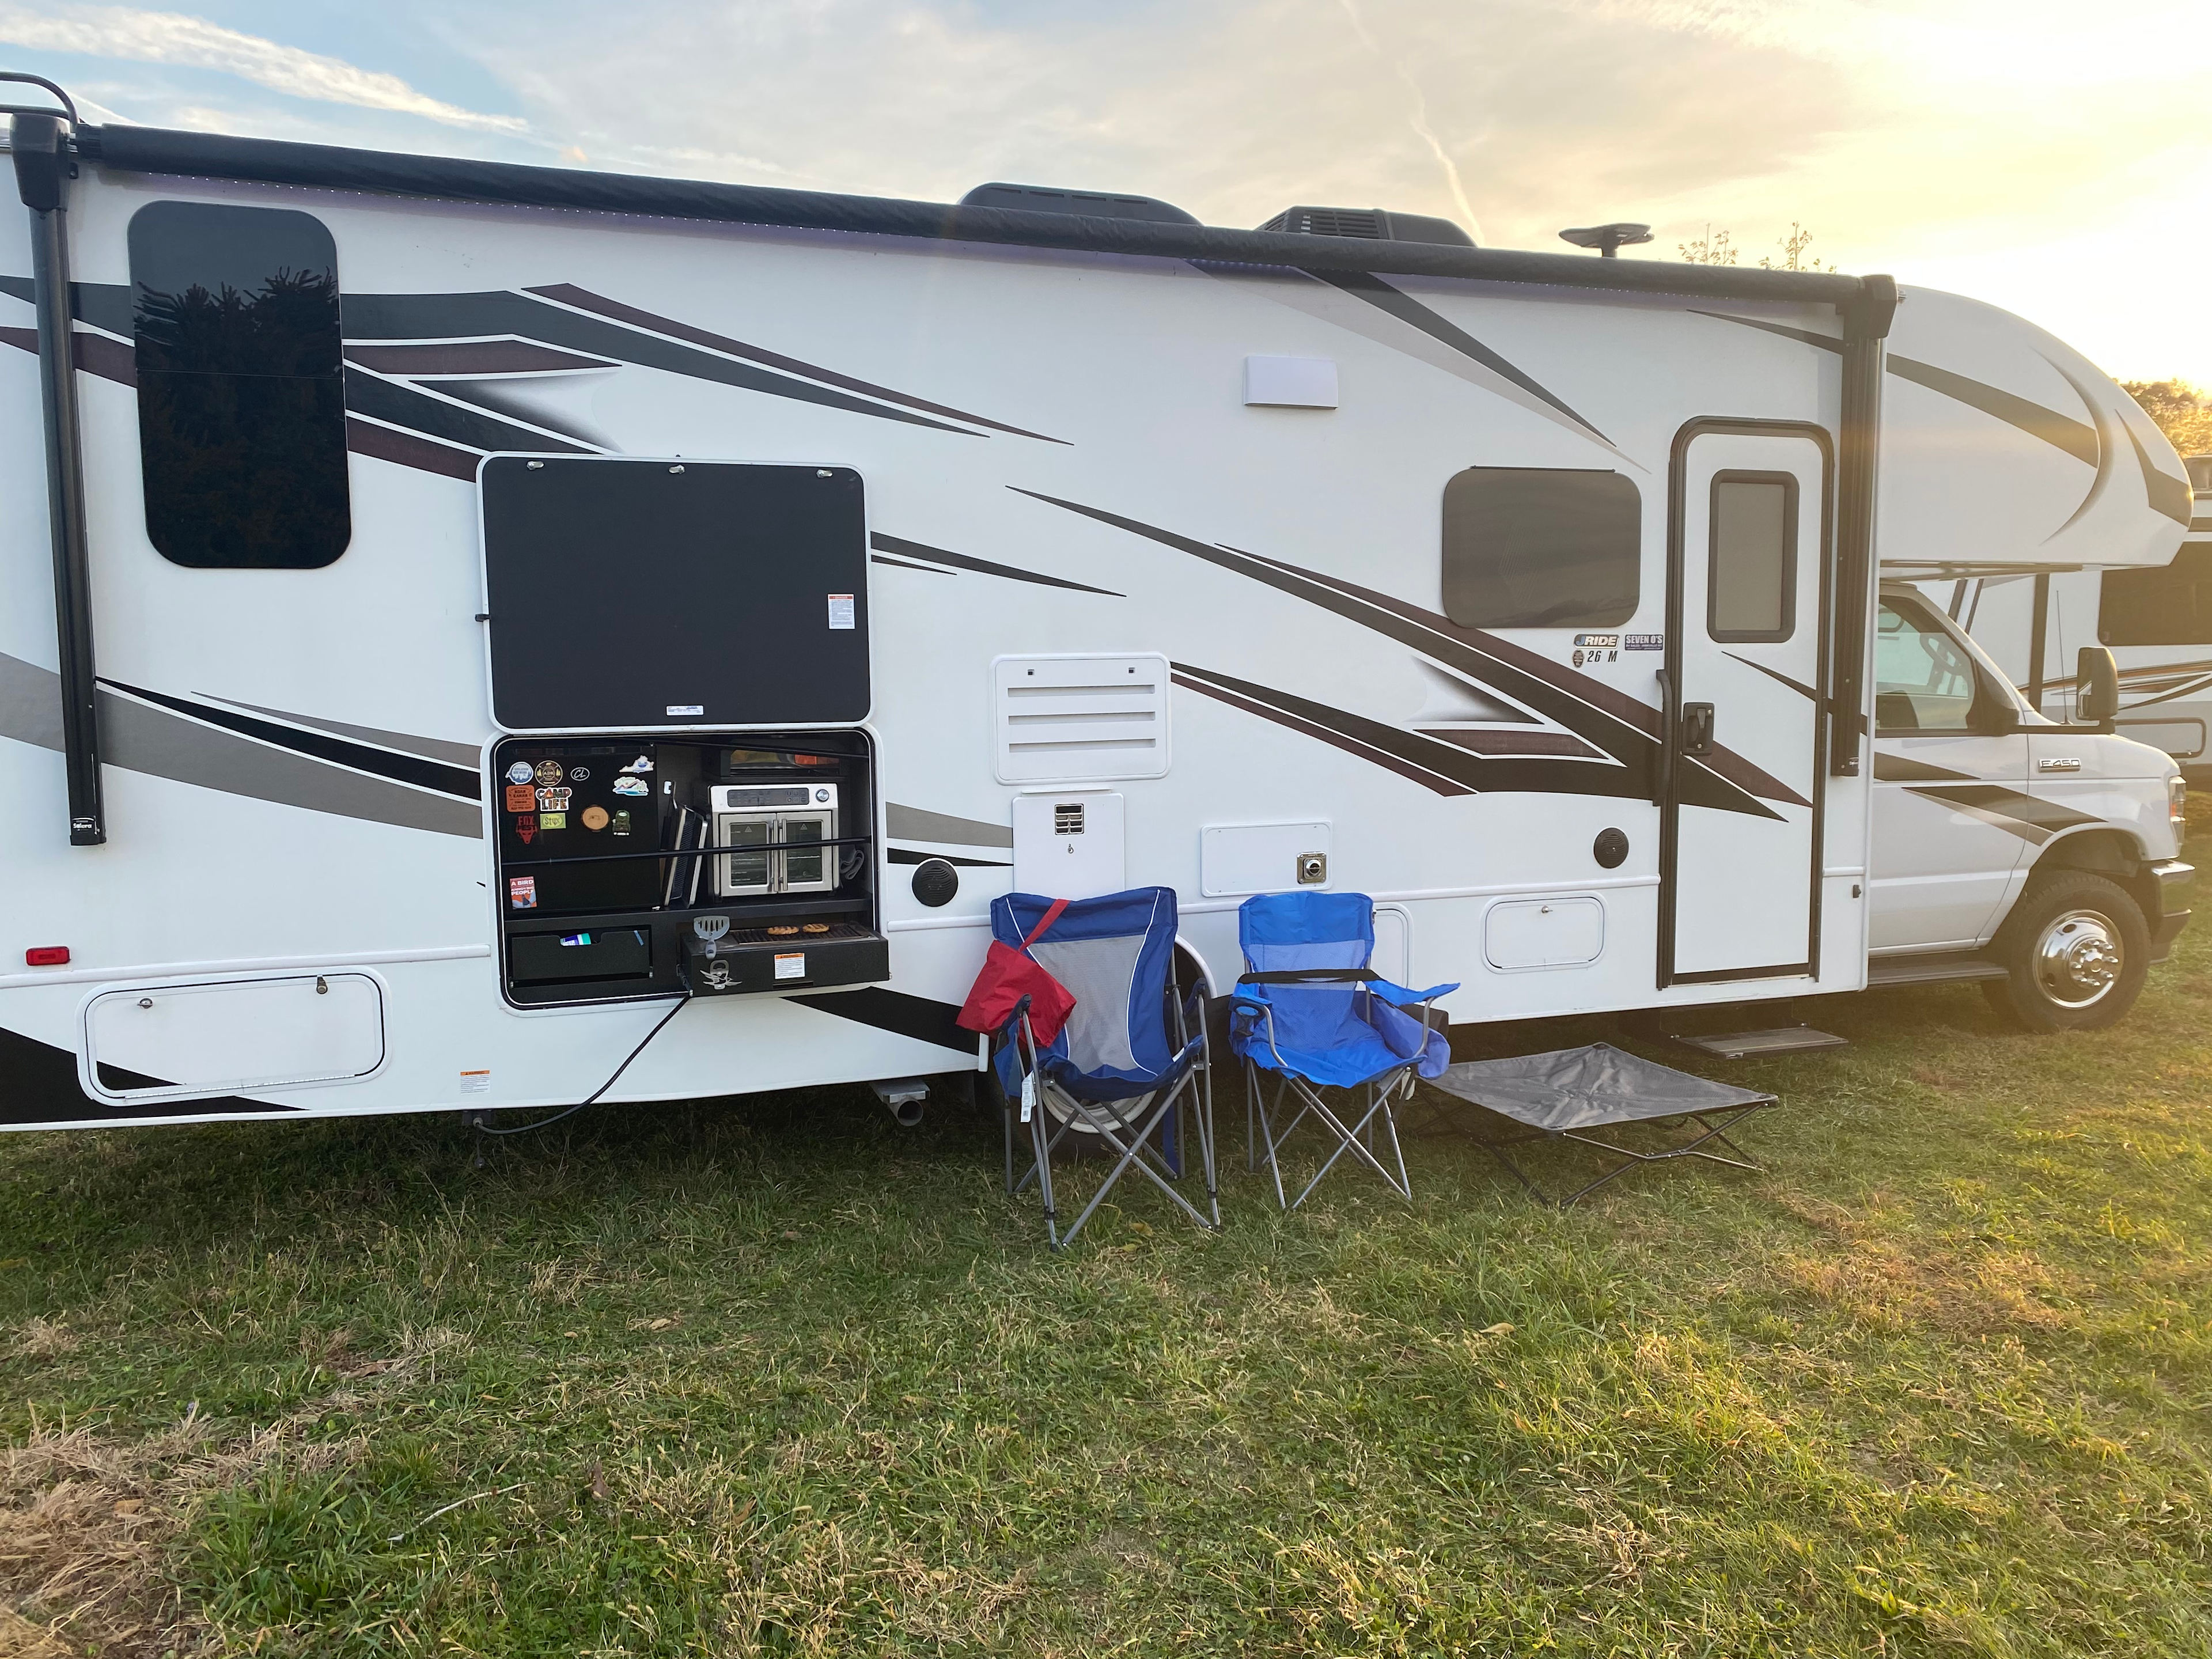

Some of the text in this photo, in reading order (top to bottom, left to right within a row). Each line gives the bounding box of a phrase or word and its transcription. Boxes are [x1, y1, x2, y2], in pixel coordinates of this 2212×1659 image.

[1575, 636, 1617, 646] JRIDE
[1626, 635, 1662, 644] SEVEN O'S
[1587, 650, 1601, 662] 26
[1608, 650, 1618, 662] M
[537, 789, 570, 798] CAMP
[542, 798, 567, 810] LIFE
[518, 816, 533, 825] FOX
